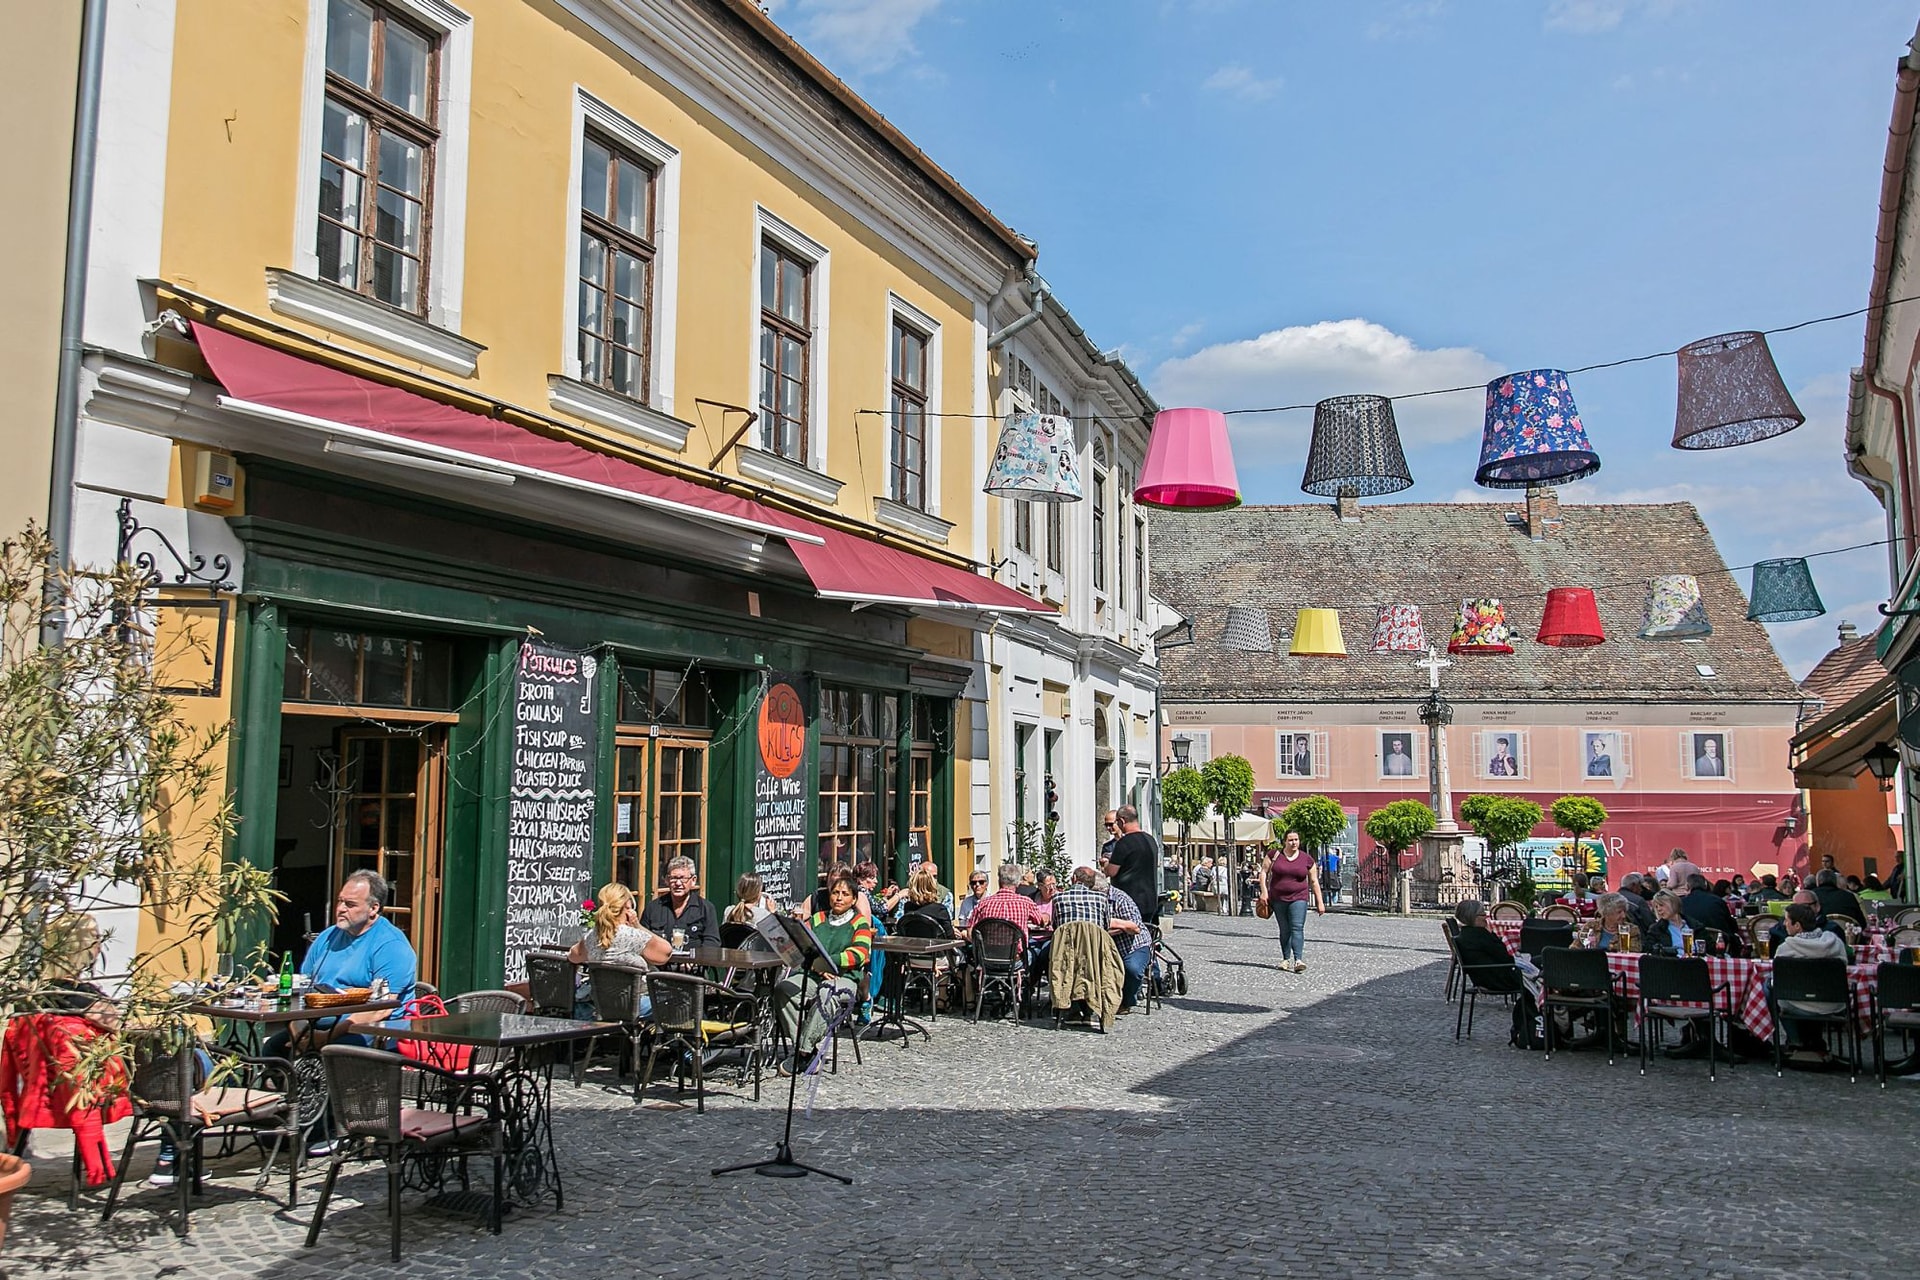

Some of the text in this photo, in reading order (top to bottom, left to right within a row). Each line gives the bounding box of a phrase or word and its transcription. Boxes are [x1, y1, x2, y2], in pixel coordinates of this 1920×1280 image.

[519, 682, 554, 700] BROTH
[517, 702, 563, 723] GOULASH
[516, 724, 541, 748] FISH
[542, 730, 567, 748] SOUP
[516, 748, 587, 773] CHICKEN PAPRIKA
[514, 768, 581, 788] ROASTED DUCK
[781, 778, 801, 795] Wine
[510, 800, 545, 820] TANYASI
[755, 799, 806, 817] HOT CHOCOLATE
[755, 815, 801, 836] CHAMPAGNE
[755, 842, 775, 861] OPEN
[508, 859, 542, 882] BÉCSI
[544, 862, 576, 882] SZELET
[508, 884, 577, 905] SZTRAPACSKA
[1535, 1015, 1544, 1038] FILA
